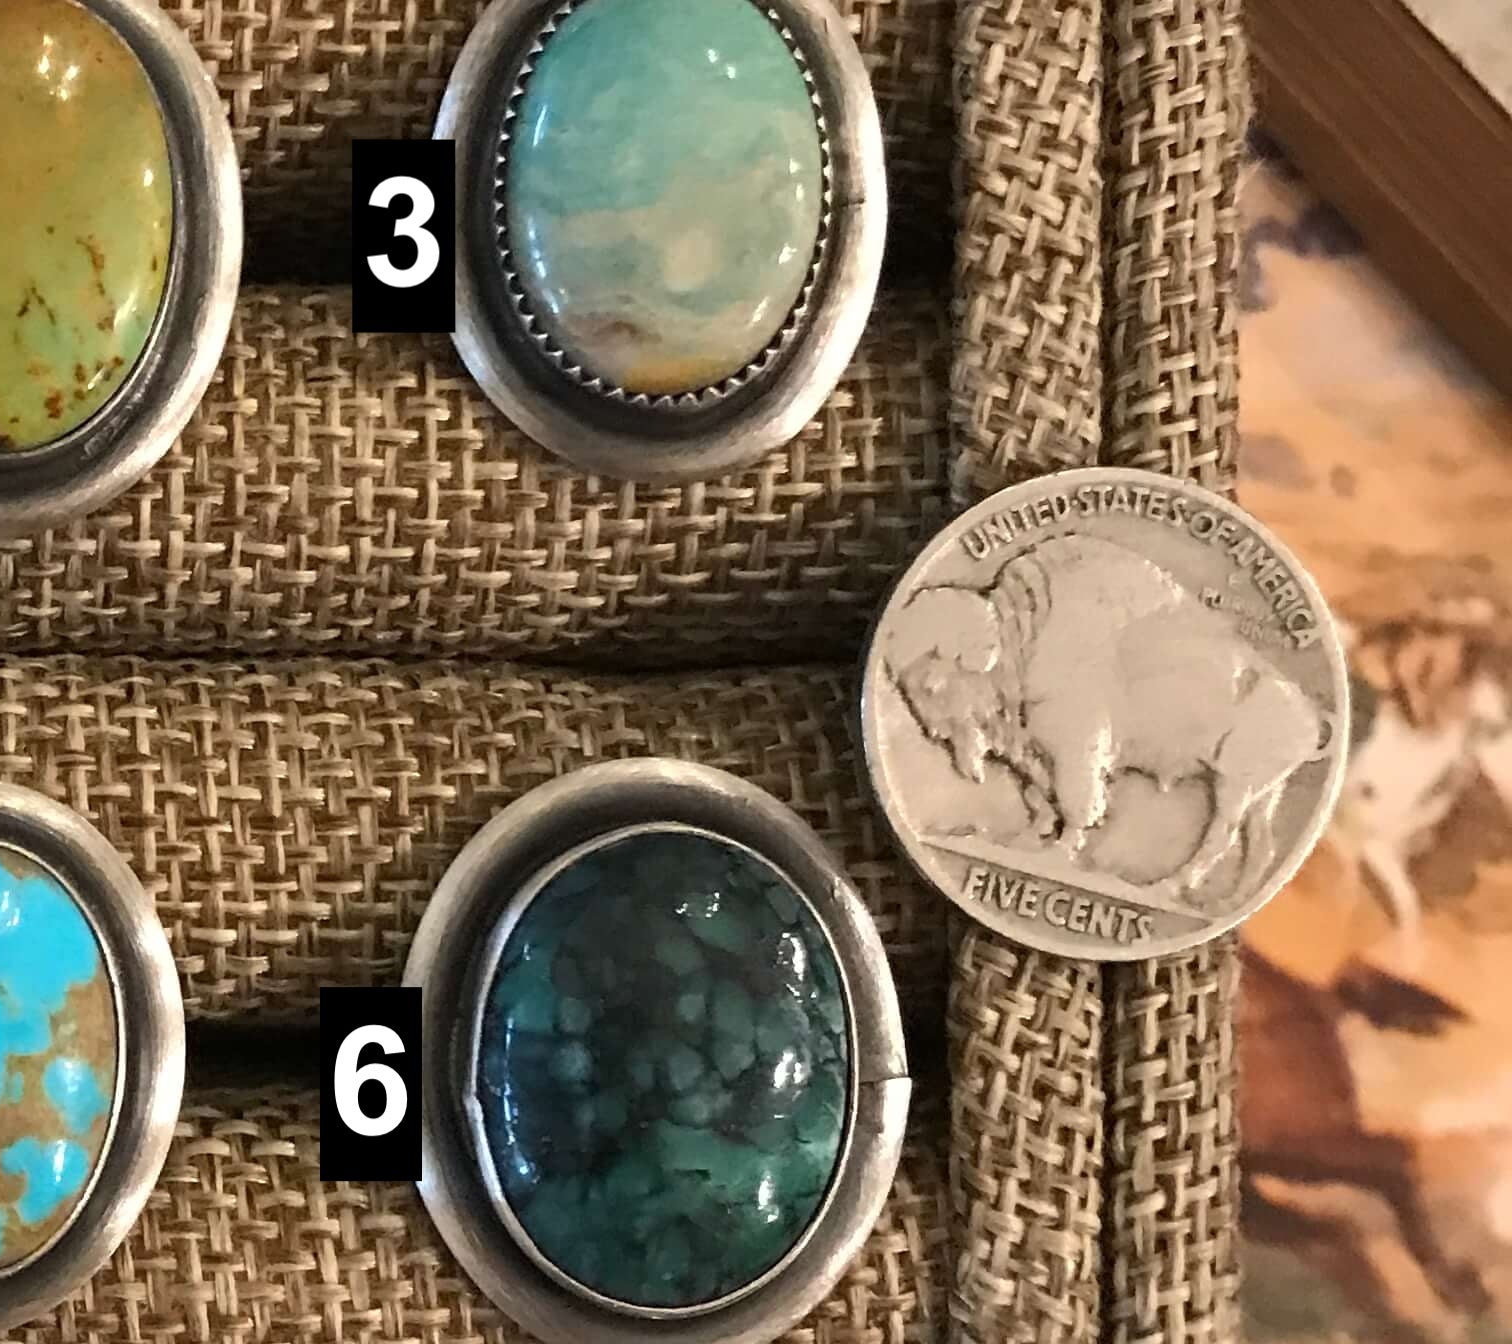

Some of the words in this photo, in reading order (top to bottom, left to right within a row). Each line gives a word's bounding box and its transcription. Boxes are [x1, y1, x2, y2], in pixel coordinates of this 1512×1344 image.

[961, 495, 1071, 559] UNITED
[1076, 485, 1187, 527] STATES
[1190, 510, 1236, 544] OF
[1226, 536, 1320, 649] AMERICA
[964, 866, 1039, 918] FIVE
[1044, 889, 1154, 944] CENTS
